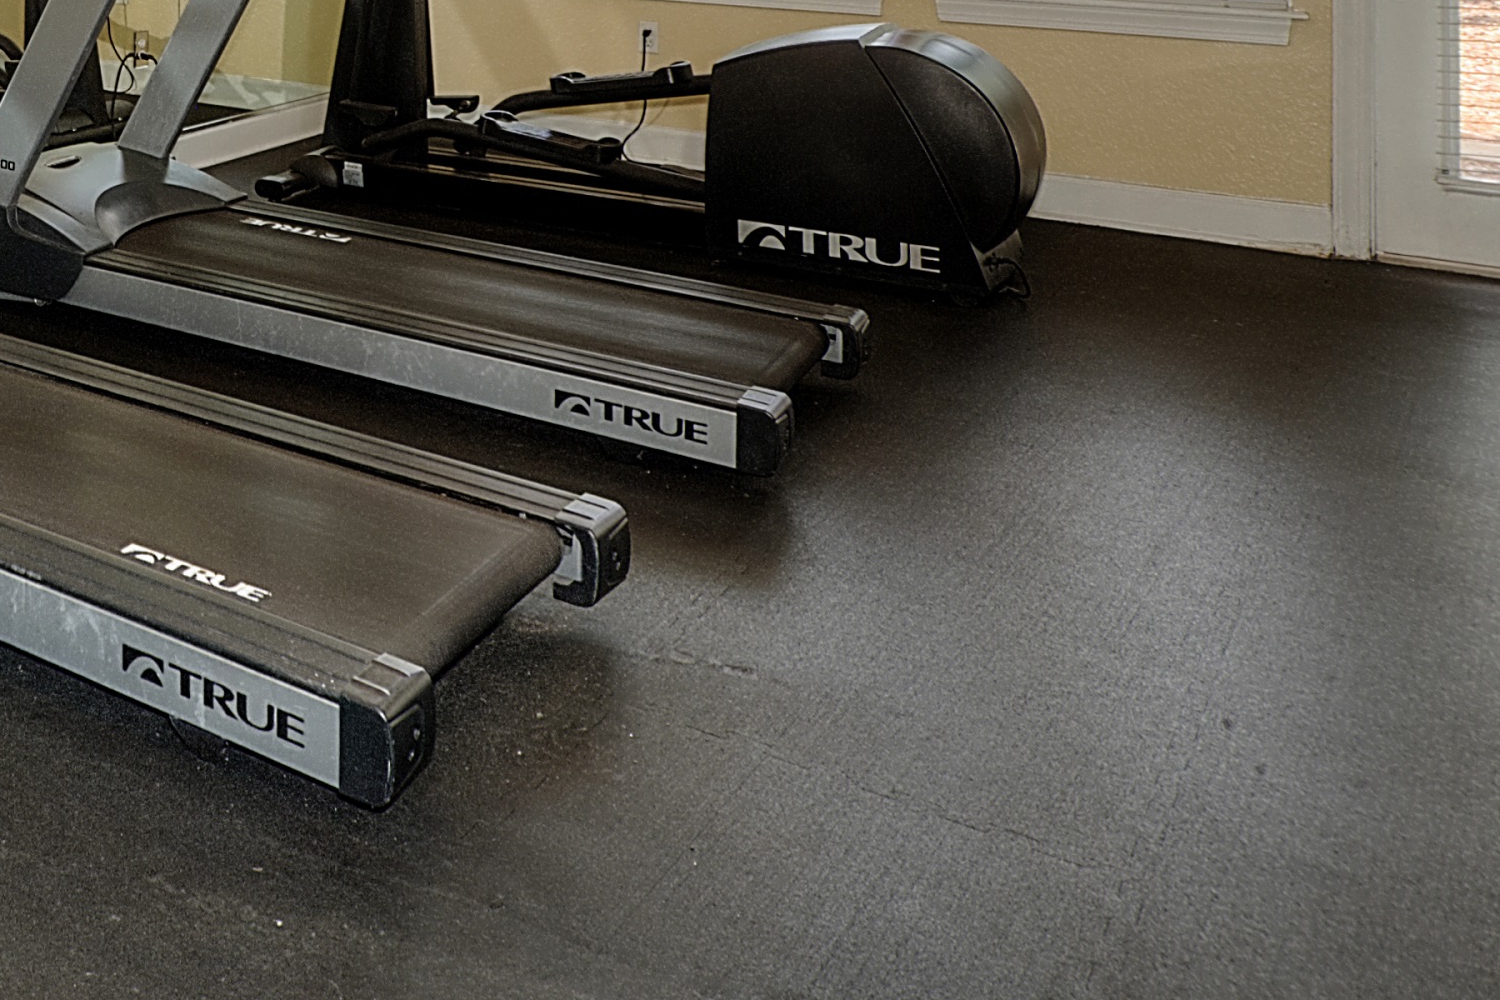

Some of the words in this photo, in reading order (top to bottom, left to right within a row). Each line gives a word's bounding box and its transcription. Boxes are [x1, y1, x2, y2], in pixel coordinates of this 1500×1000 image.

[788, 226, 941, 274] TRUE
[594, 398, 708, 445] TRUE
[163, 555, 272, 602] TRUE
[168, 662, 305, 749] TRUE
